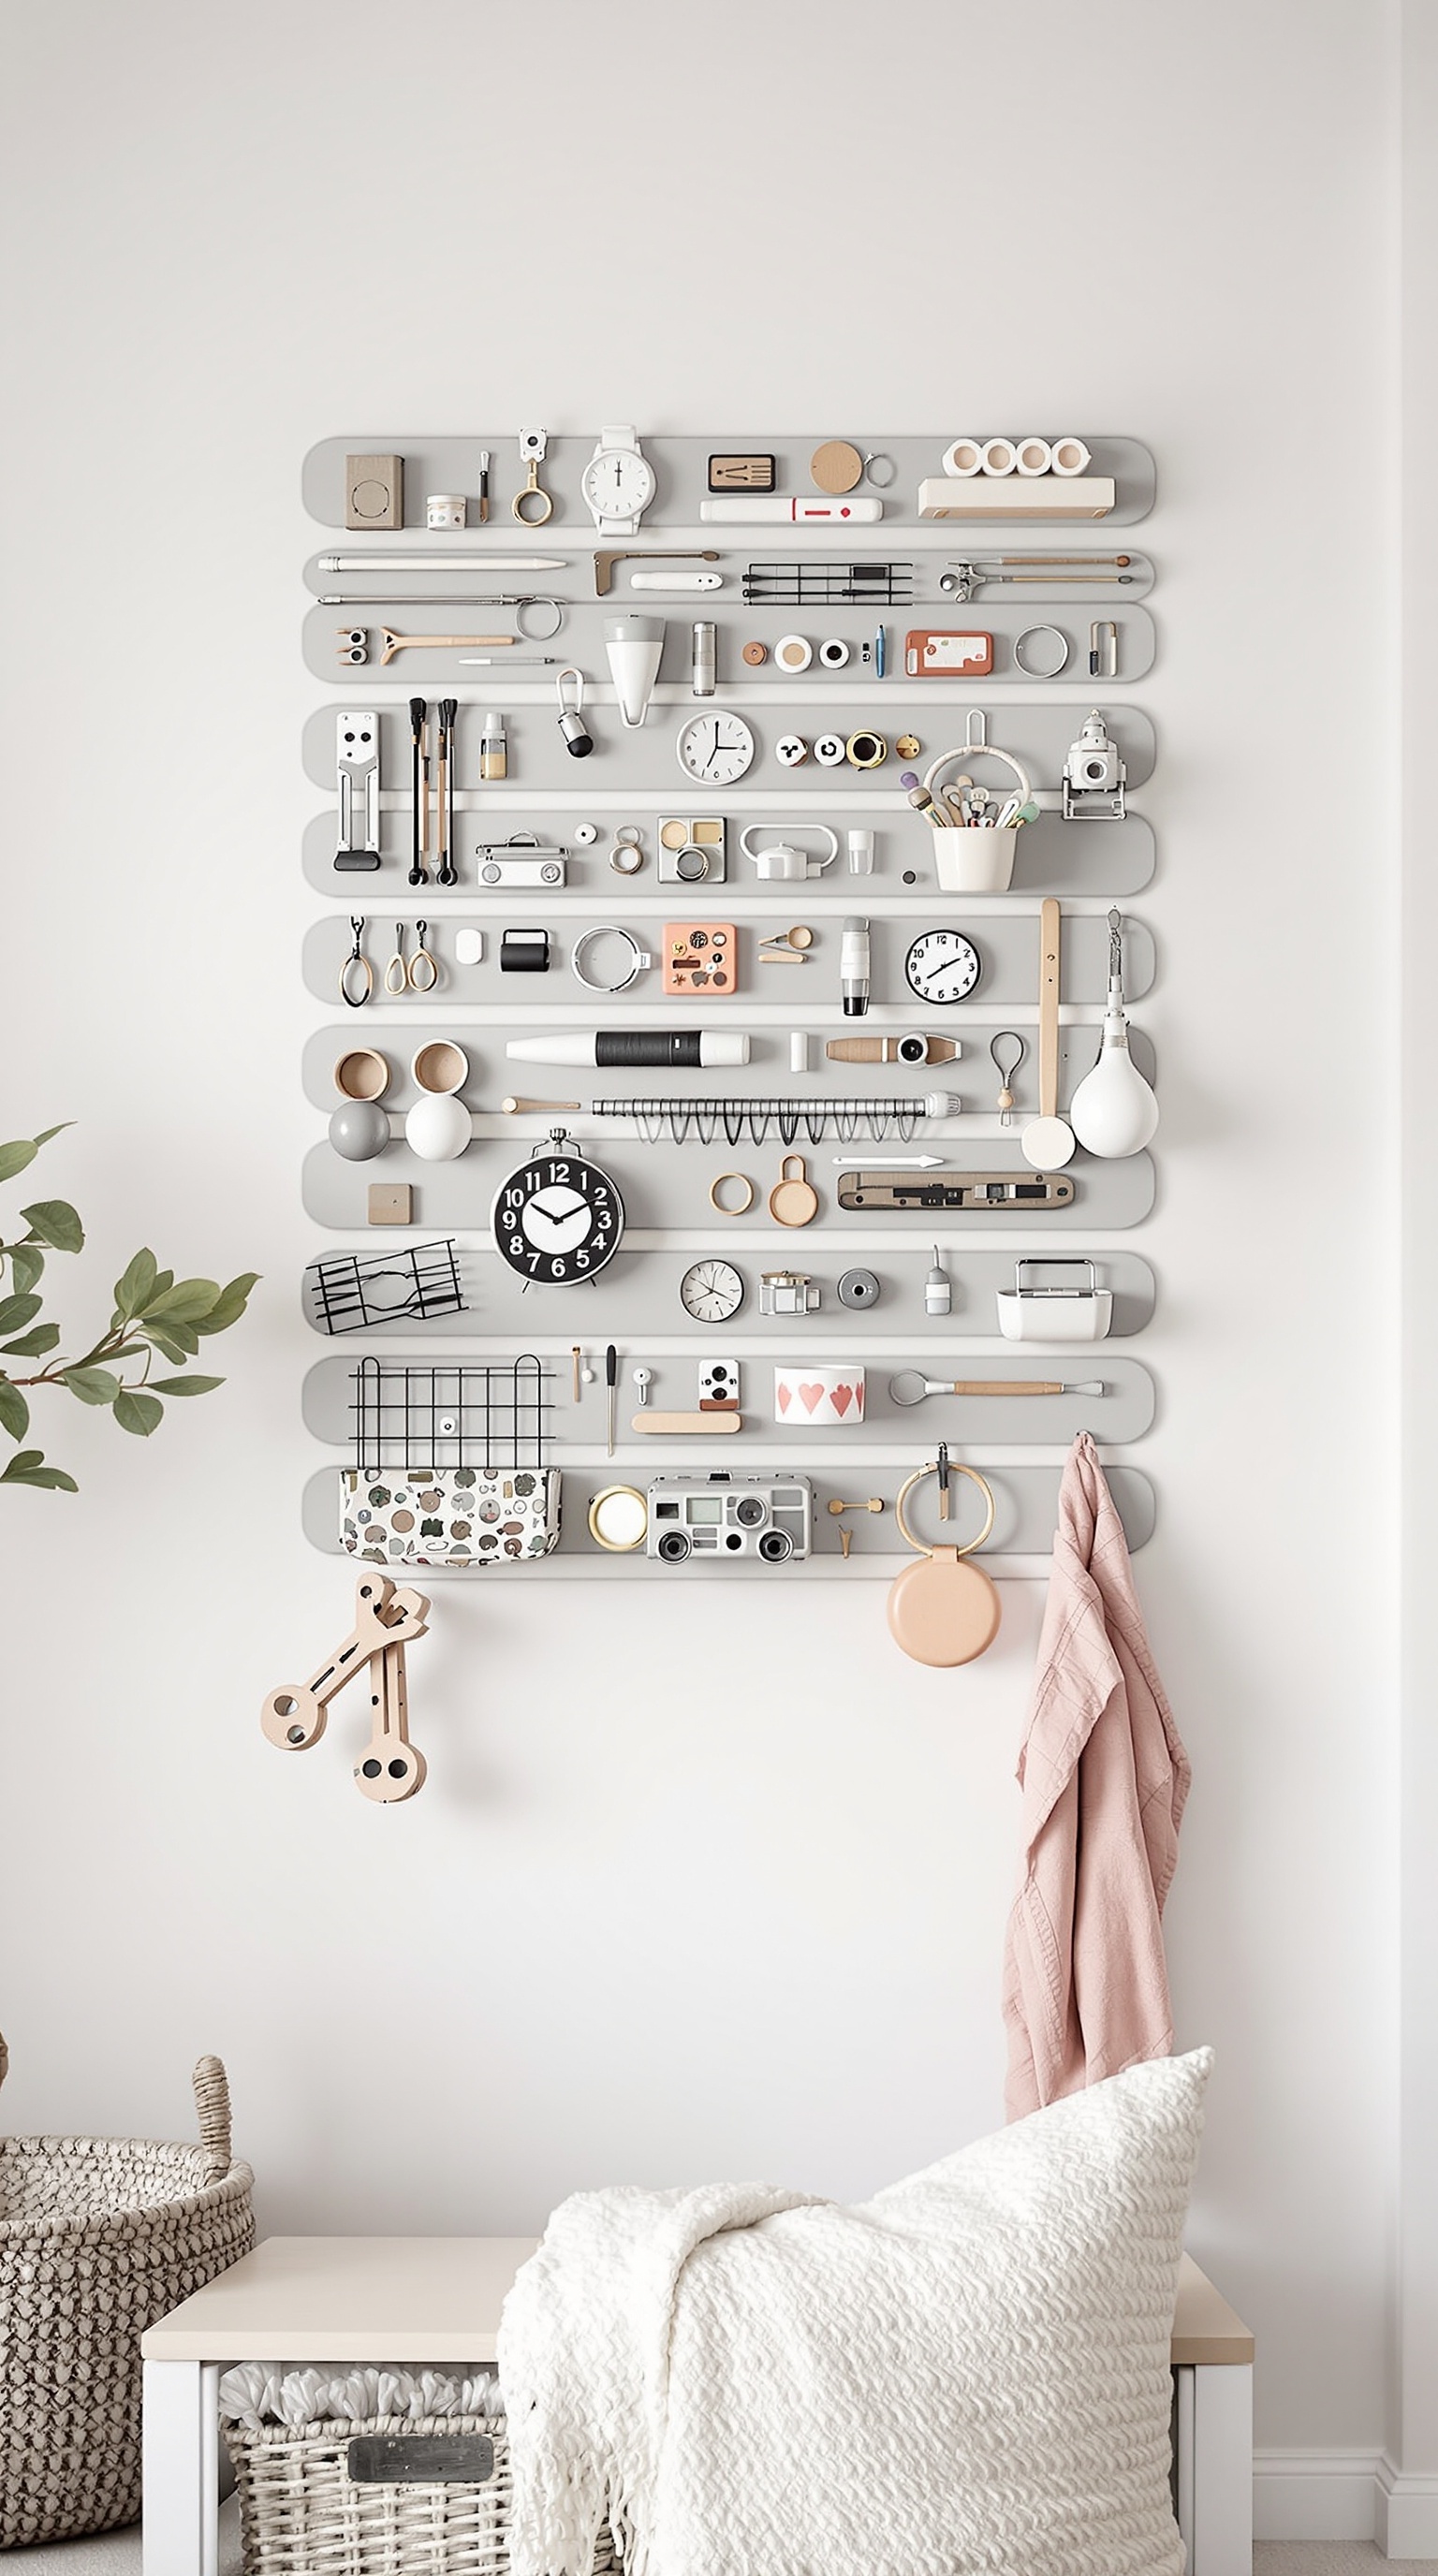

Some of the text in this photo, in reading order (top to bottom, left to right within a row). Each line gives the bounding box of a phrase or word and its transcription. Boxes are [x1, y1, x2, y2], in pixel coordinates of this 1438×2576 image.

[913, 948, 924, 959] 10
[962, 948, 971, 959] 2
[914, 975, 921, 986] 8
[962, 976, 970, 987] 4
[938, 988, 945, 999] 6
[952, 987, 960, 996] 5
[525, 1172, 541, 1192] 11
[549, 1163, 570, 1183] 12
[580, 1171, 587, 1191] 1
[505, 1189, 524, 1208] 10
[594, 1187, 608, 1207] 2
[502, 1209, 517, 1230] 9
[597, 1210, 612, 1230] 3
[509, 1235, 524, 1255] 8
[591, 1232, 608, 1251] 4
[526, 1252, 541, 1272] 7
[550, 1257, 566, 1278] 6
[576, 1249, 590, 1268] 5
